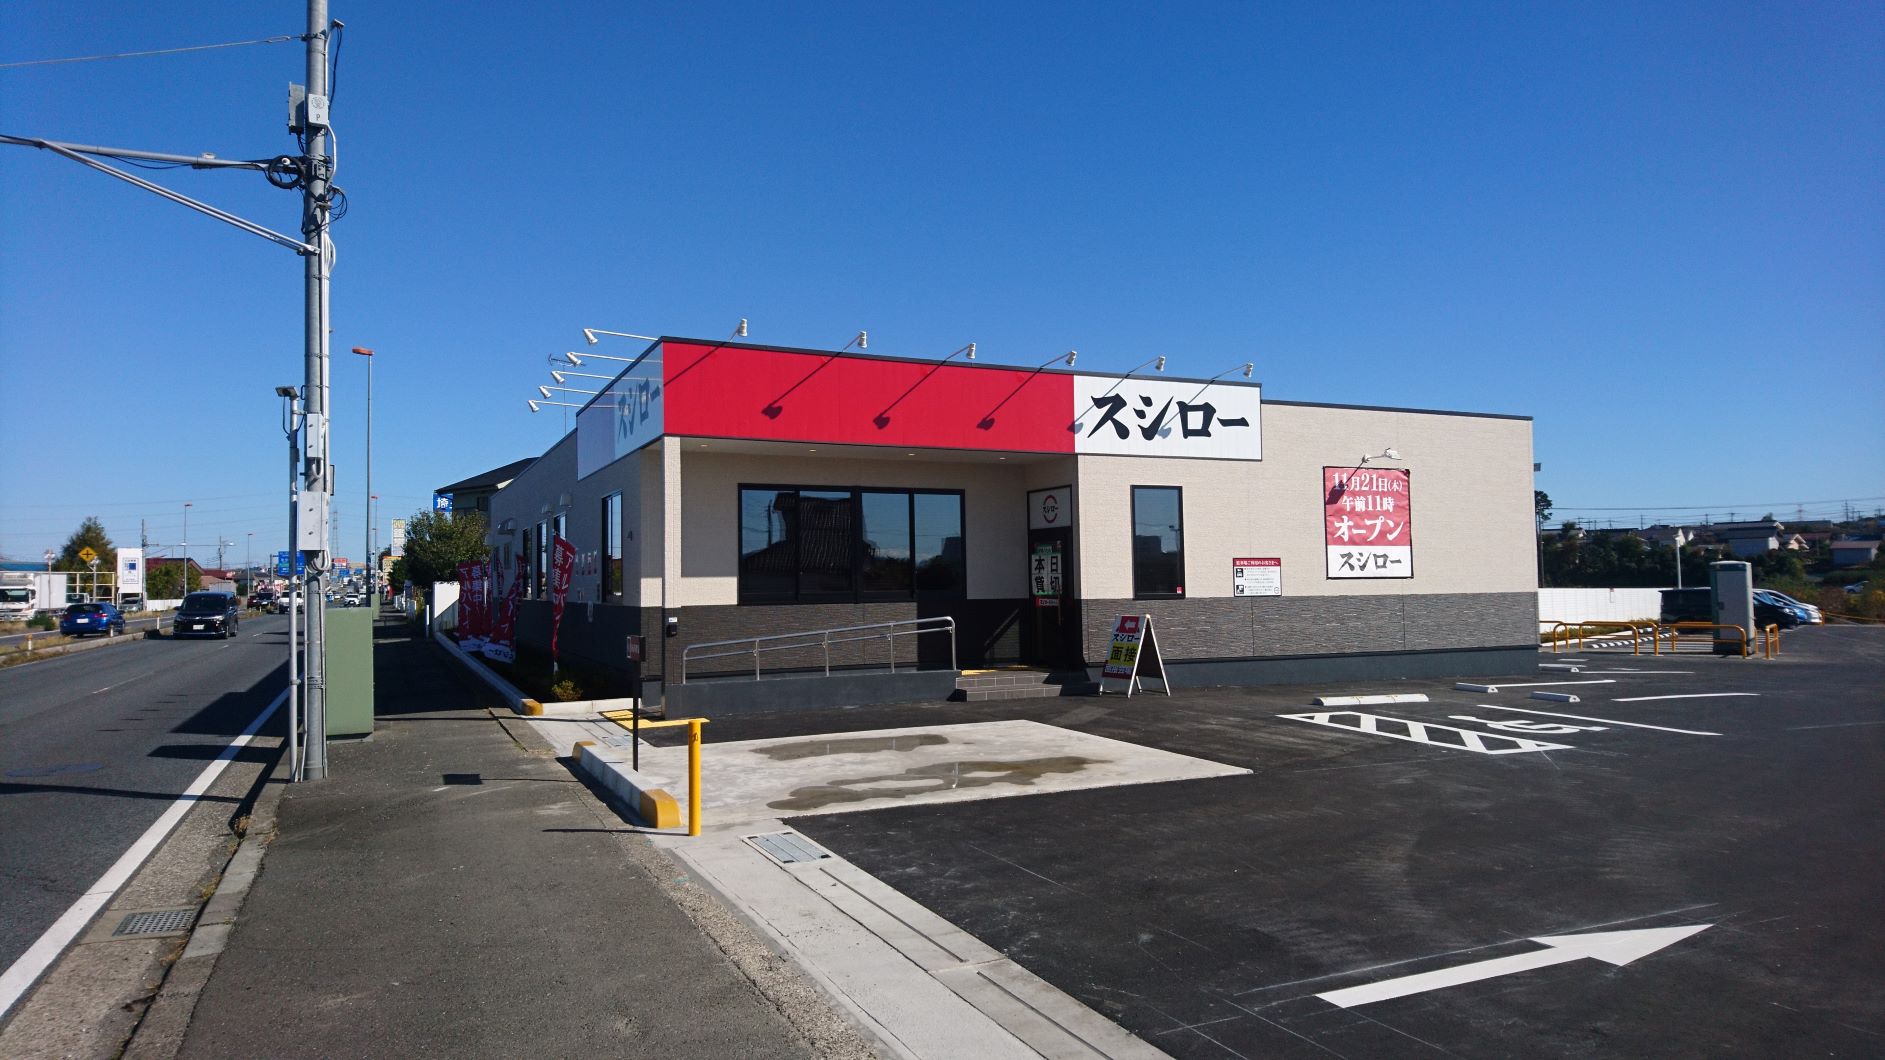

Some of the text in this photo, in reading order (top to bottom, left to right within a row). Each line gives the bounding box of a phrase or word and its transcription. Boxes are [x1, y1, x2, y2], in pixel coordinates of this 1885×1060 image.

[618, 377, 661, 443] スシロー
[1087, 393, 1250, 441] スシロー
[1333, 472, 1403, 492] 11月21日(木)
[1342, 495, 1395, 512] 午前11時
[1334, 515, 1404, 542] オープン
[1338, 551, 1402, 572] スシロー
[1112, 634, 1140, 642] スシロー
[1110, 645, 1137, 662] 面接
